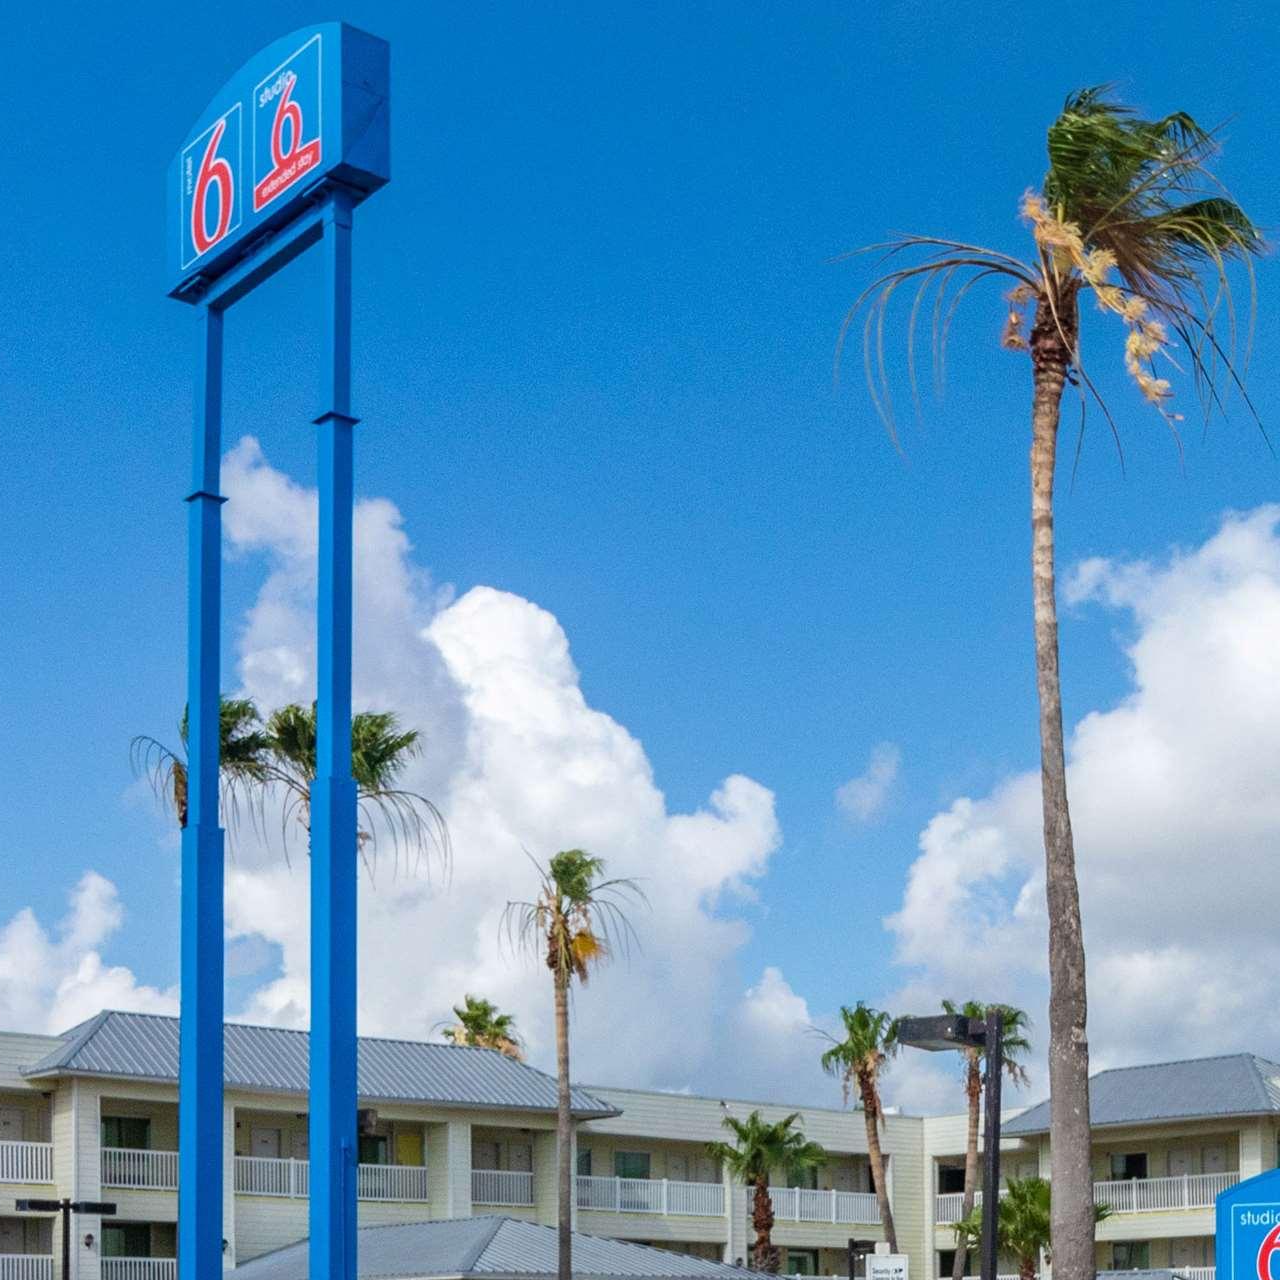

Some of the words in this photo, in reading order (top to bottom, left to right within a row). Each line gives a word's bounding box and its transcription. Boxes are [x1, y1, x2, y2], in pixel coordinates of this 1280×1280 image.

[259, 70, 295, 108] studio
[271, 73, 303, 167] 6
[192, 118, 235, 256] 6
[261, 161, 297, 198] extended
[297, 150, 315, 172] stay
